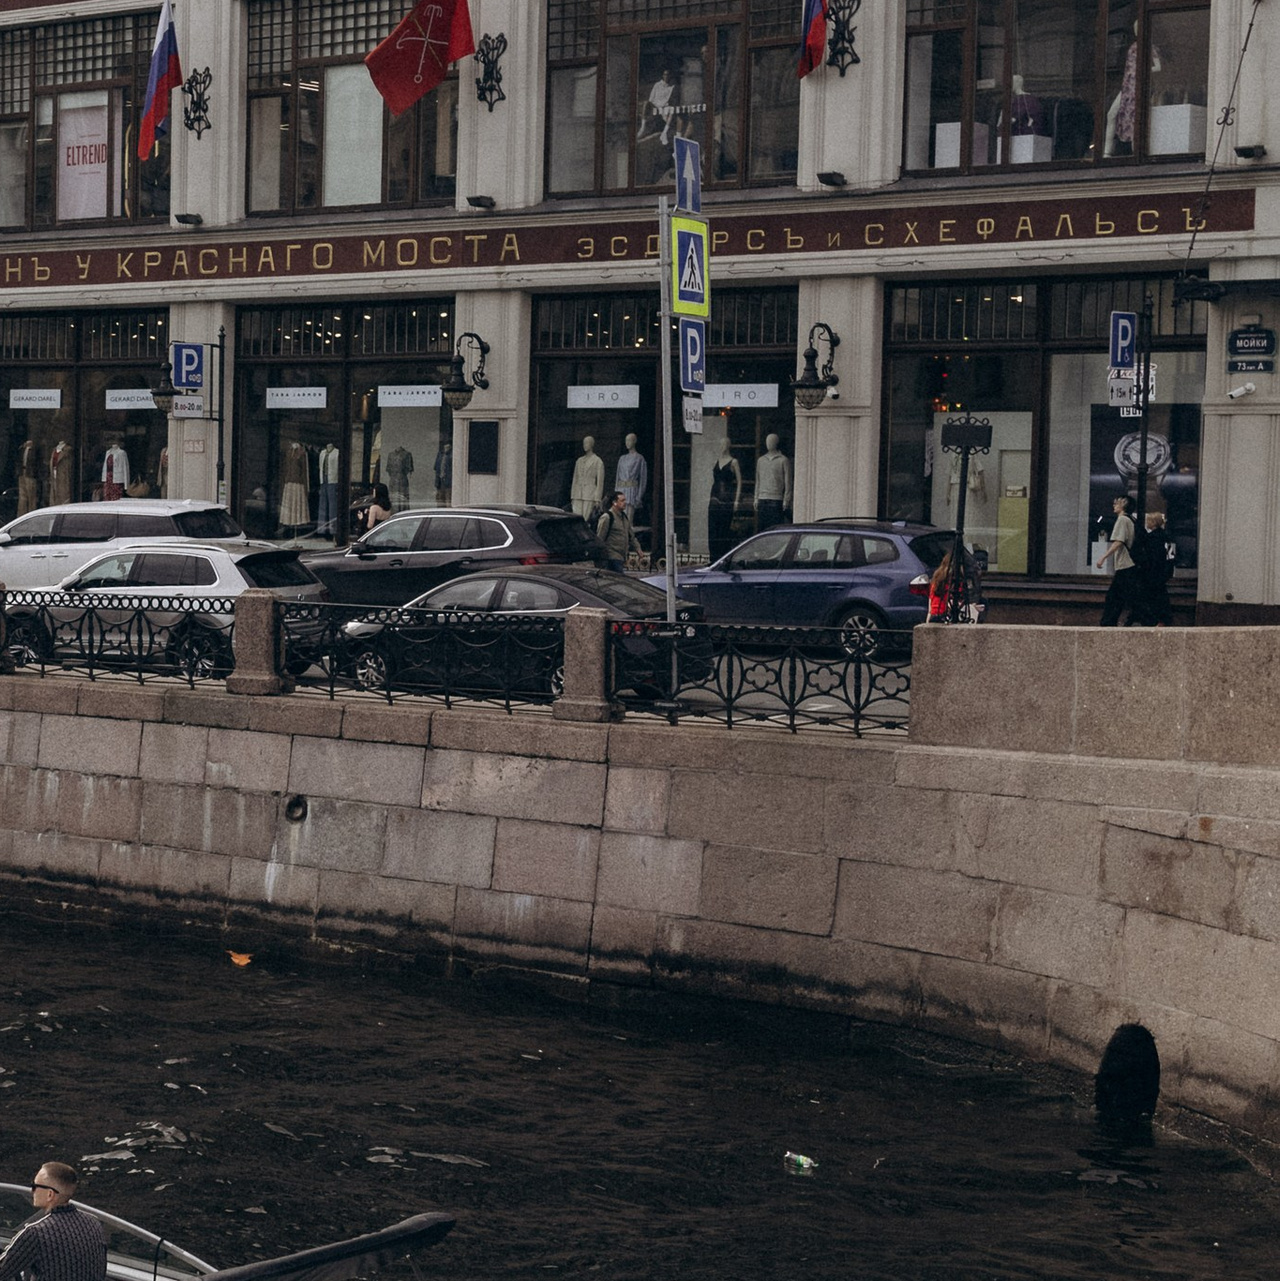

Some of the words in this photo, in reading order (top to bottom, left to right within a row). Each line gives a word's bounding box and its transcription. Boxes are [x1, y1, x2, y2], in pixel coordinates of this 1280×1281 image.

[66, 144, 107, 167] ELTREND
[75, 254, 92, 280] У
[116, 242, 334, 278] КРАСНАГО
[362, 233, 521, 268] МОСТА
[577, 227, 805, 258] ЭСДРСЪ
[864, 208, 1207, 246] СХЕФАЛЬСЪ
[1236, 336, 1268, 348] МОЙКИ
[1237, 362, 1247, 371] 73
[586, 392, 620, 402] IRO
[721, 390, 757, 401] IRO
